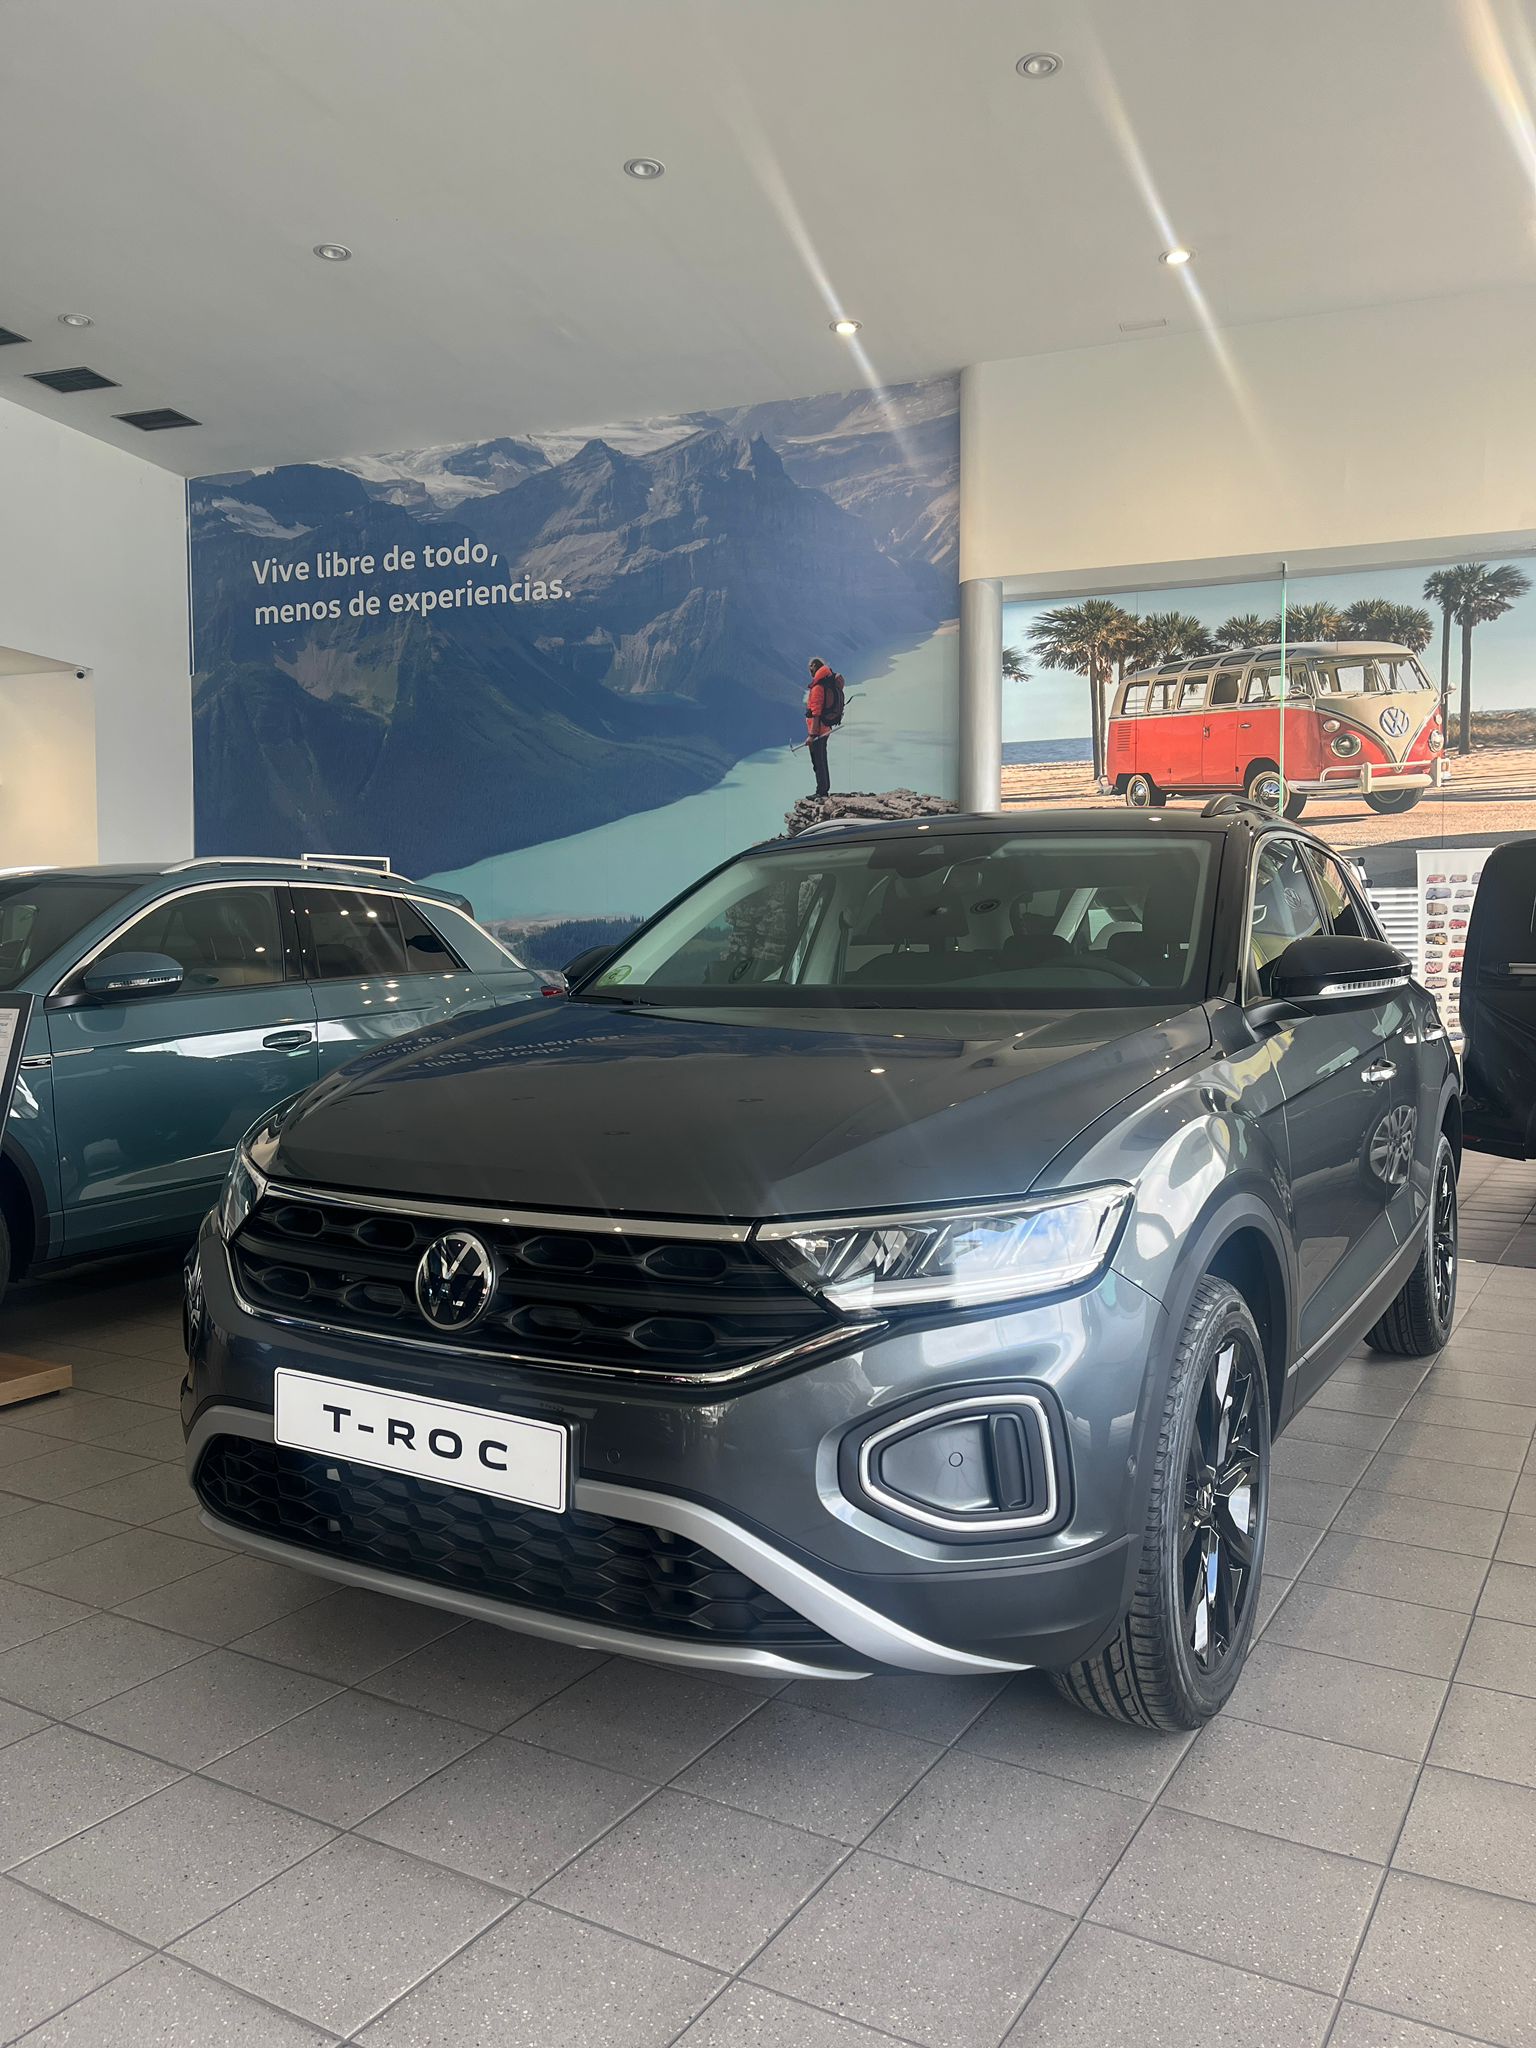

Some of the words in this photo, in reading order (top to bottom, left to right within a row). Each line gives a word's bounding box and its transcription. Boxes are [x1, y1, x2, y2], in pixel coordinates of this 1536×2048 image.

[252, 557, 310, 585] Vive
[316, 551, 375, 579] libre
[383, 544, 416, 572] de
[422, 537, 498, 568] todo,
[255, 599, 342, 626] menos
[348, 590, 381, 617] de
[388, 574, 572, 617] experiencias.
[323, 1404, 508, 1471] T-ROC
